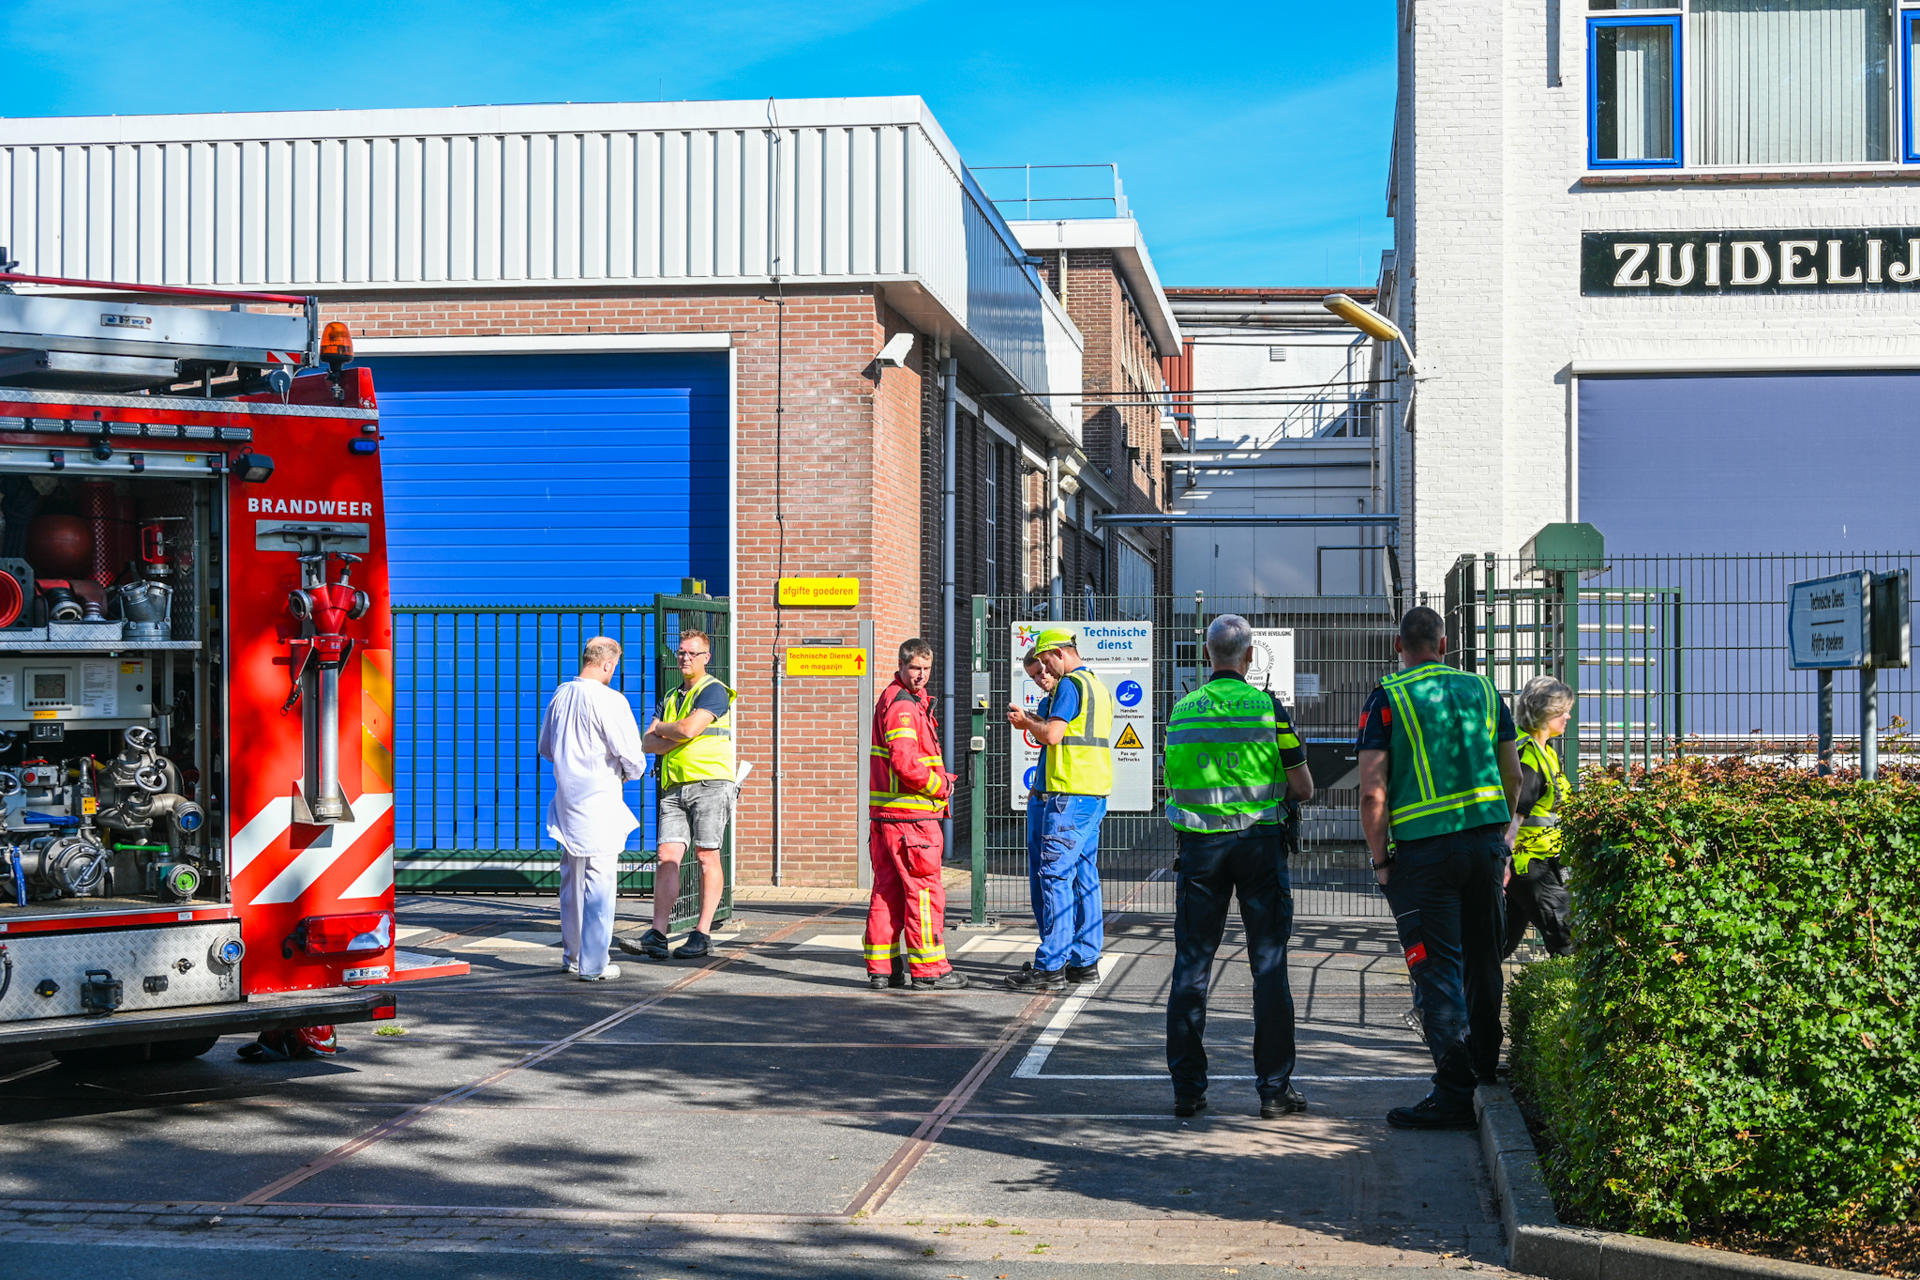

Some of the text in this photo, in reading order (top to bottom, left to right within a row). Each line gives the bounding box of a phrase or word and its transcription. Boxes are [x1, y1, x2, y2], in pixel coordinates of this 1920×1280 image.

[248, 497, 373, 517] BRANDWEER
[783, 586, 853, 597] afgifte goederen
[1810, 588, 1845, 610] Technische Dienst
[1083, 626, 1147, 637] Technische
[1097, 639, 1133, 650] dienst
[811, 663, 842, 671] magazijn
[1197, 752, 1239, 769] OvD
